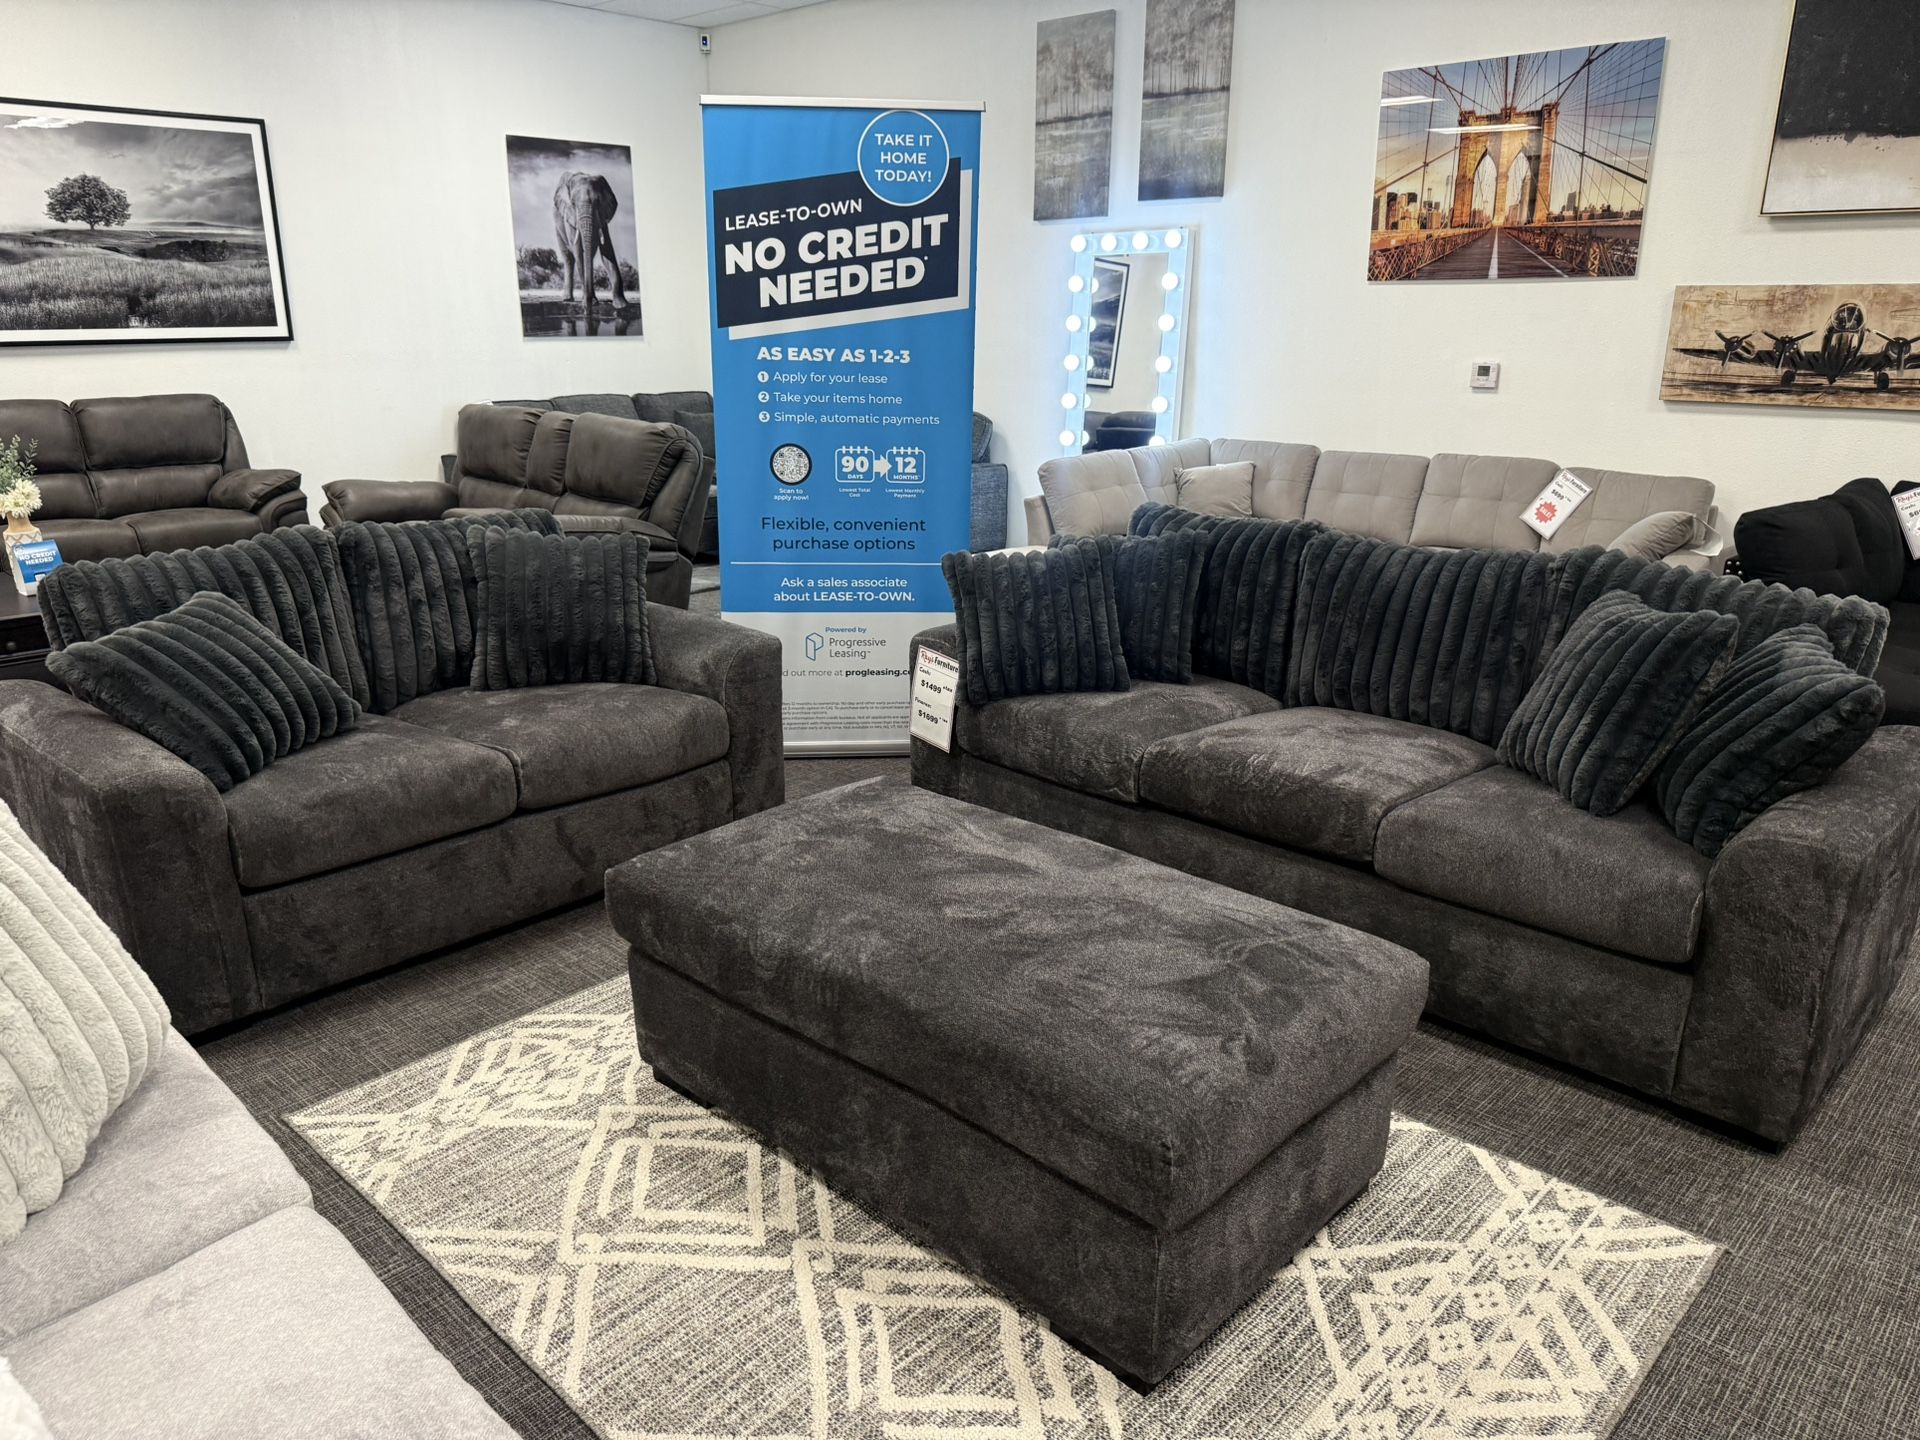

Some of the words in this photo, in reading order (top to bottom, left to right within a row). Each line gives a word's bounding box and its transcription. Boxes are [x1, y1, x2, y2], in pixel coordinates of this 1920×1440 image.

[874, 133, 915, 147] TAKE
[918, 134, 933, 147] IT
[880, 151, 927, 165] HOME
[874, 168, 932, 183] TODAY!
[725, 198, 863, 231] LEASE-TO-OWN
[725, 237, 786, 275] NO
[798, 213, 949, 264] CREDIT
[756, 346, 783, 361] AS
[787, 347, 836, 362] EASY
[840, 348, 866, 363] AS
[870, 349, 911, 364] 1-2-3
[772, 371, 808, 384] Apply
[810, 371, 827, 382] for
[829, 373, 855, 385] your
[857, 372, 888, 384] lease
[773, 391, 801, 402] Take
[803, 394, 830, 405] your
[833, 393, 866, 404] items
[868, 393, 903, 404] home
[774, 411, 818, 424] Simple,
[820, 413, 880, 425] automatic
[882, 414, 940, 426] payments
[841, 455, 870, 473] 90
[895, 456, 917, 474] 12
[760, 517, 830, 533] Flexible,
[833, 517, 927, 532] convenient
[772, 537, 849, 551] purchase
[854, 538, 916, 552] options
[19, 553, 30, 561] NO
[31, 550, 57, 559] CREDIT
[25, 556, 54, 565] NEEDED
[781, 577, 804, 587] Ask
[807, 579, 815, 587] a
[817, 577, 848, 588] sales
[851, 577, 908, 588] associate
[773, 591, 811, 601] about
[813, 591, 915, 602] LEASE-TO-OWN.
[857, 626, 867, 634] by
[829, 637, 887, 649] Progressive
[934, 656, 959, 673] Furniture
[791, 669, 806, 677] out
[834, 669, 844, 677] at
[921, 679, 942, 694] $1499
